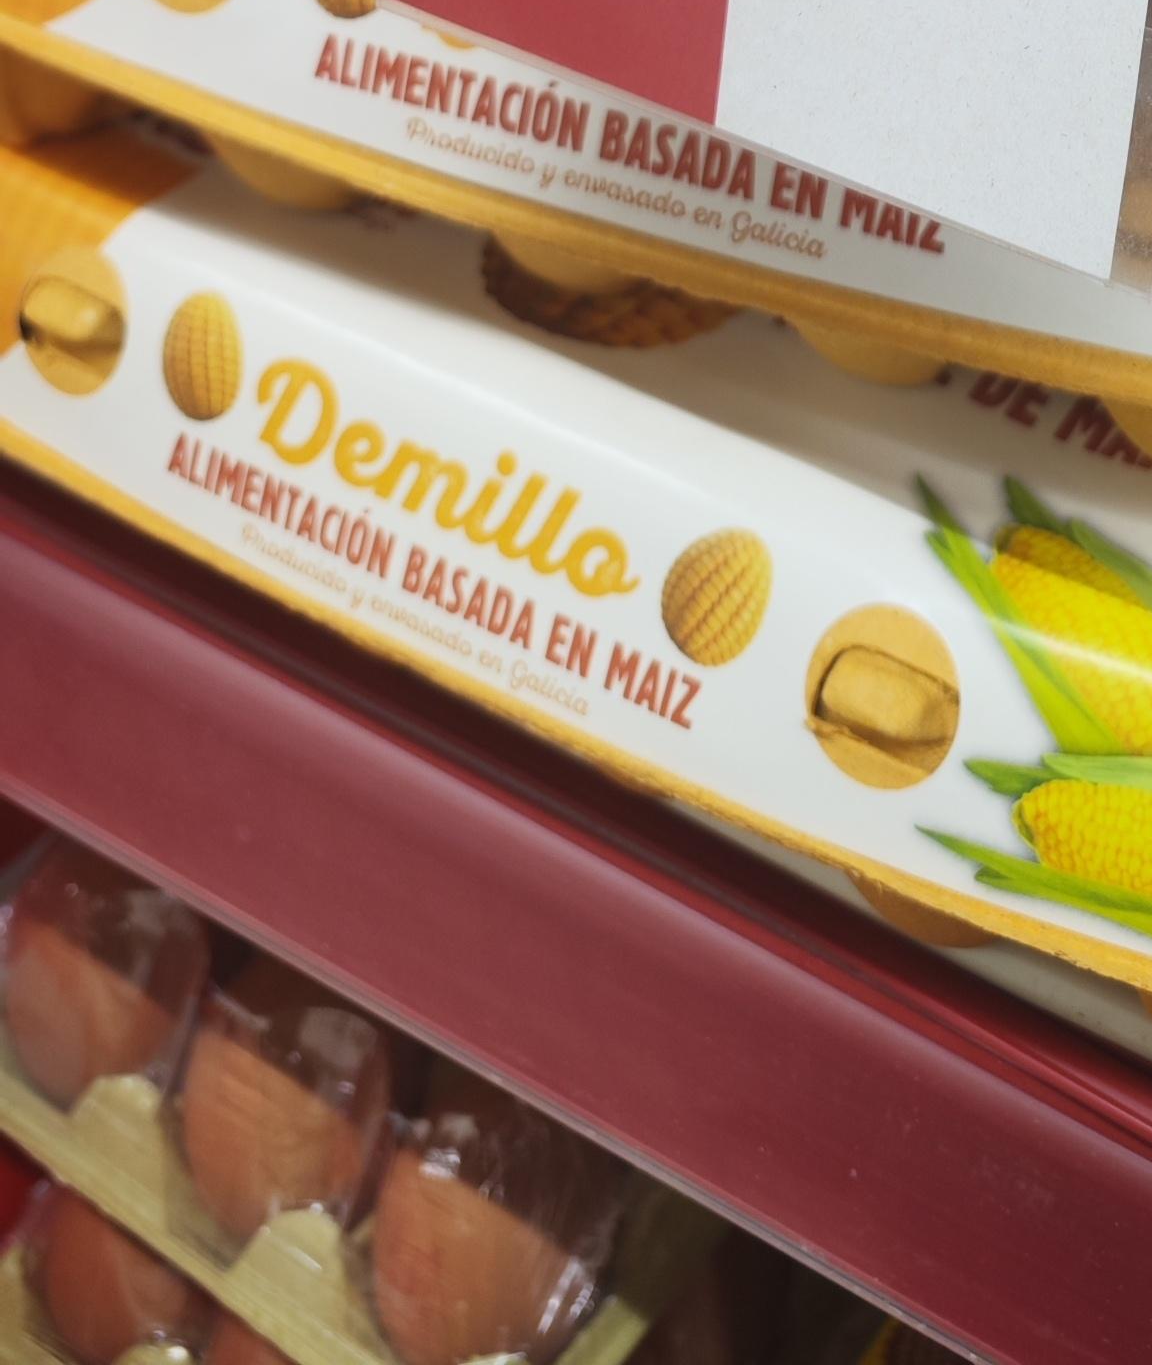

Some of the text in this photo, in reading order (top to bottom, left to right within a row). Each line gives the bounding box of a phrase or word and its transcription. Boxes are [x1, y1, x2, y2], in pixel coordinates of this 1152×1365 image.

[314, 32, 591, 154] ALIMENTACIÓN
[599, 109, 757, 201] BASADA
[771, 160, 829, 221] EN
[406, 116, 829, 260] Producido y envasado en Galicia
[168, 431, 702, 730] ALIMENTACIÓN BASADA EN MAIZ
[257, 356, 640, 597] Demillo
